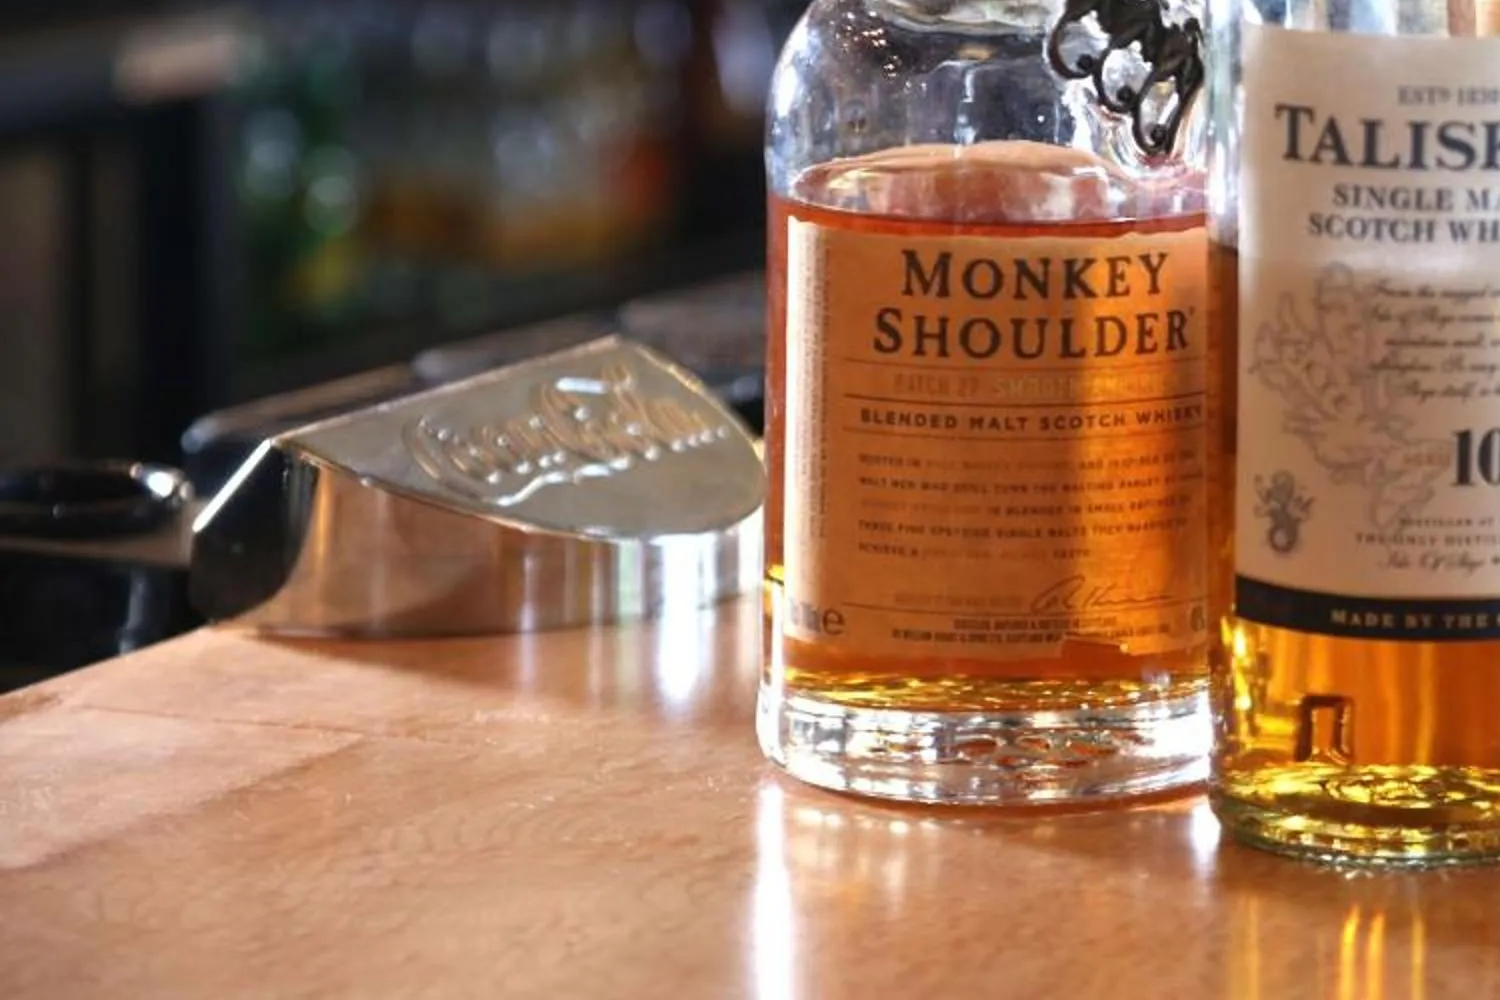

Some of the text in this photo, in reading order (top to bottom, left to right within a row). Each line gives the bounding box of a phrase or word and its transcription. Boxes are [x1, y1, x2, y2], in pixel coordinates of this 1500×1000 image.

[1332, 183, 1455, 212] SINGLE
[1308, 212, 1437, 243] SCOTCH
[901, 249, 1169, 300] MONKEY
[873, 307, 1191, 360] SHOULDER
[860, 403, 1202, 432] BLENDED MALT SCOTCH WHISKY
[1331, 608, 1395, 629] MADE
[1404, 613, 1433, 631] BY
[1442, 612, 1486, 631] THE
